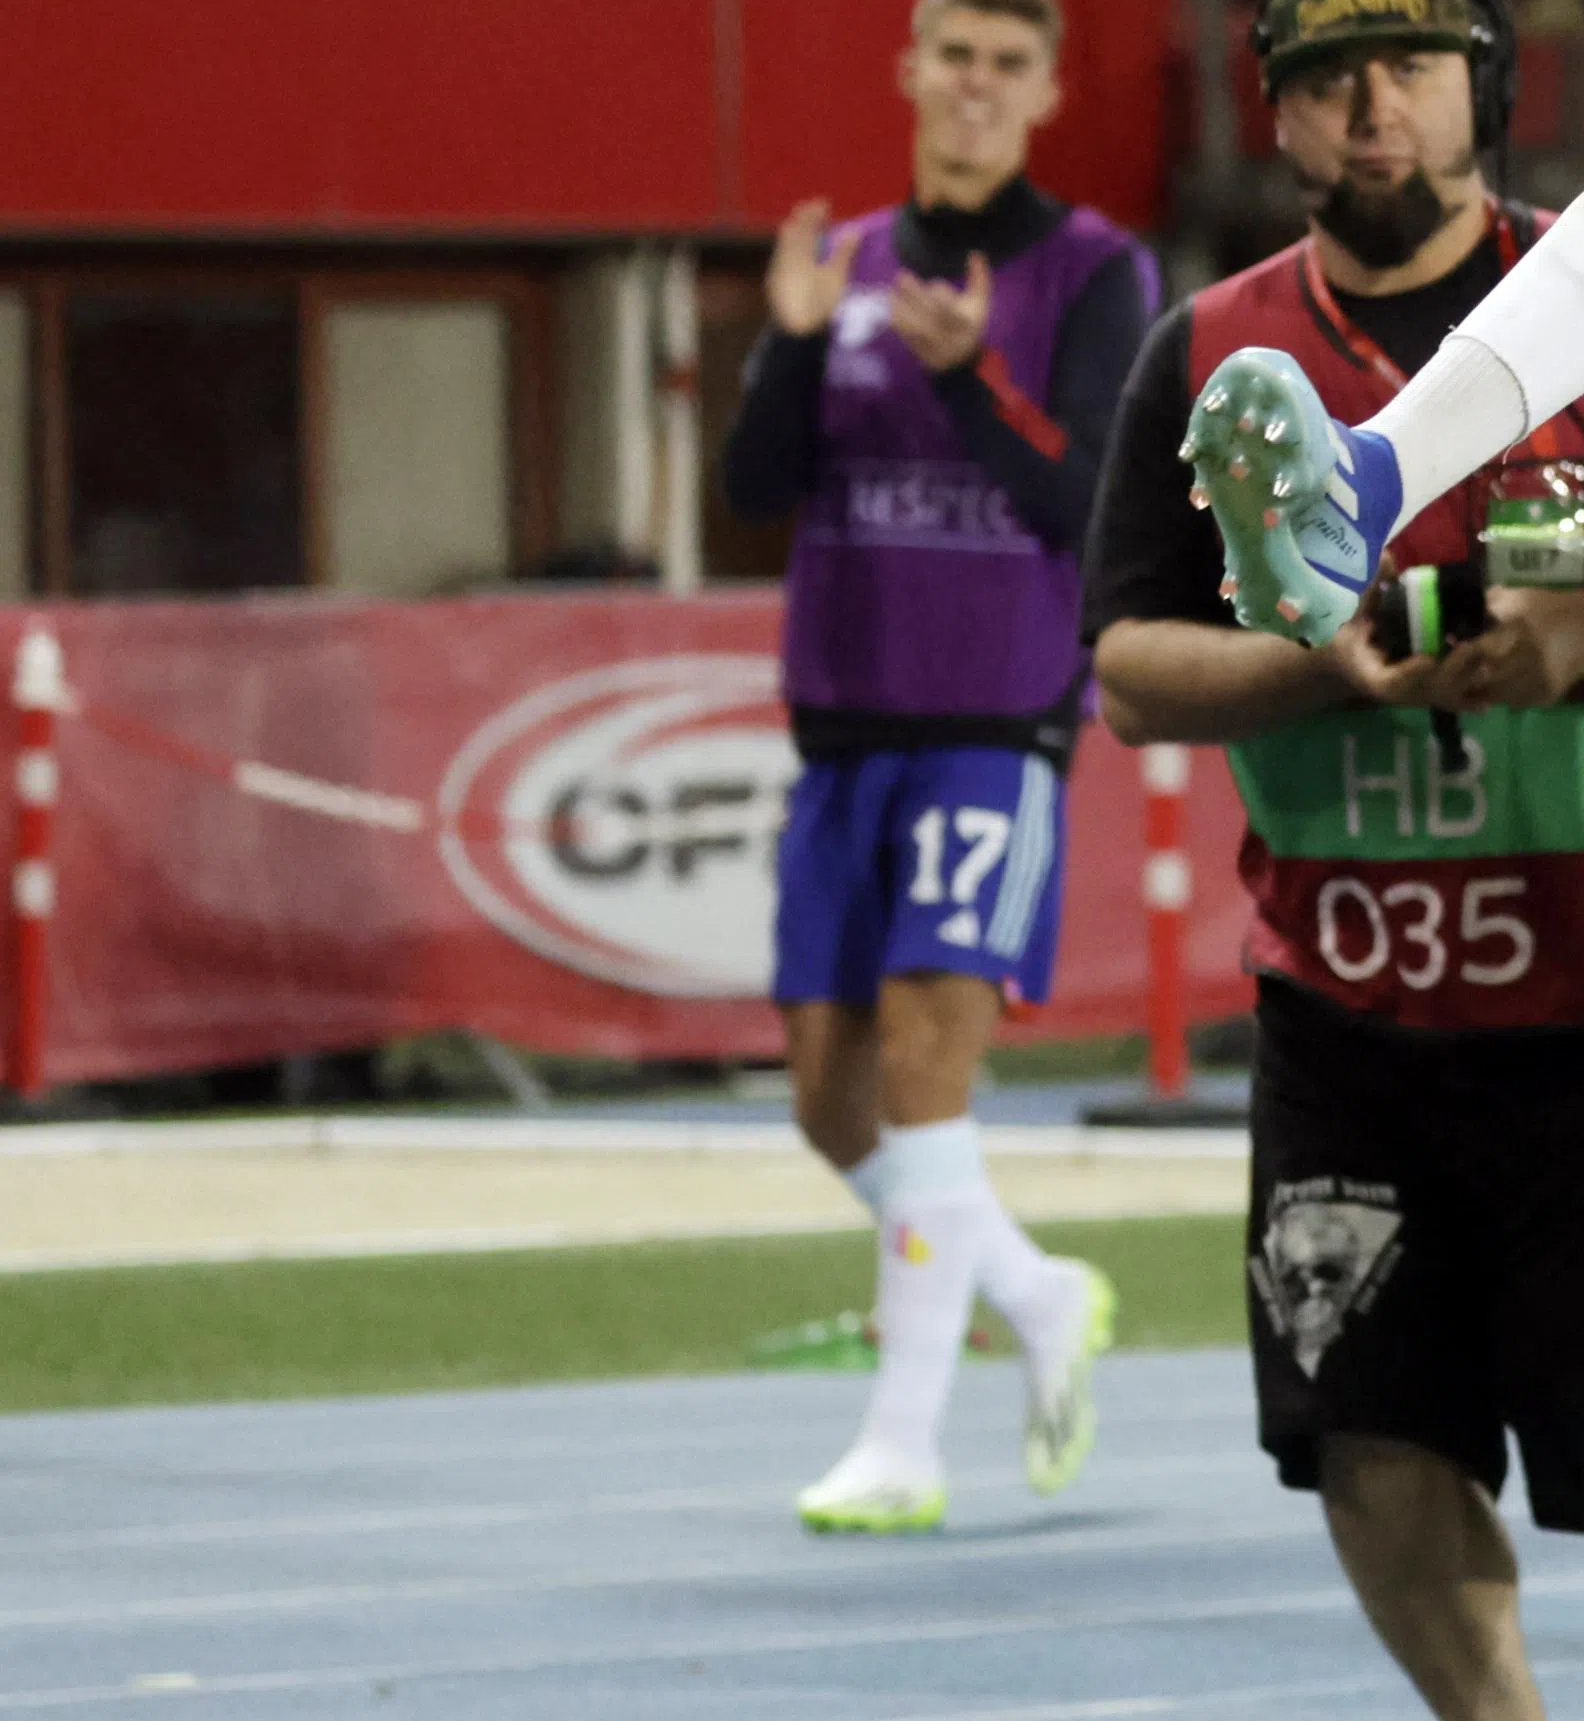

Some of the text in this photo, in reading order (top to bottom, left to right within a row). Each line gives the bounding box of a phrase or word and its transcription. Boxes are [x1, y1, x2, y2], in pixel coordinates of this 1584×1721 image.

[1342, 733, 1488, 838] HB
[911, 806, 1010, 905] 17
[1317, 876, 1535, 990] 035
